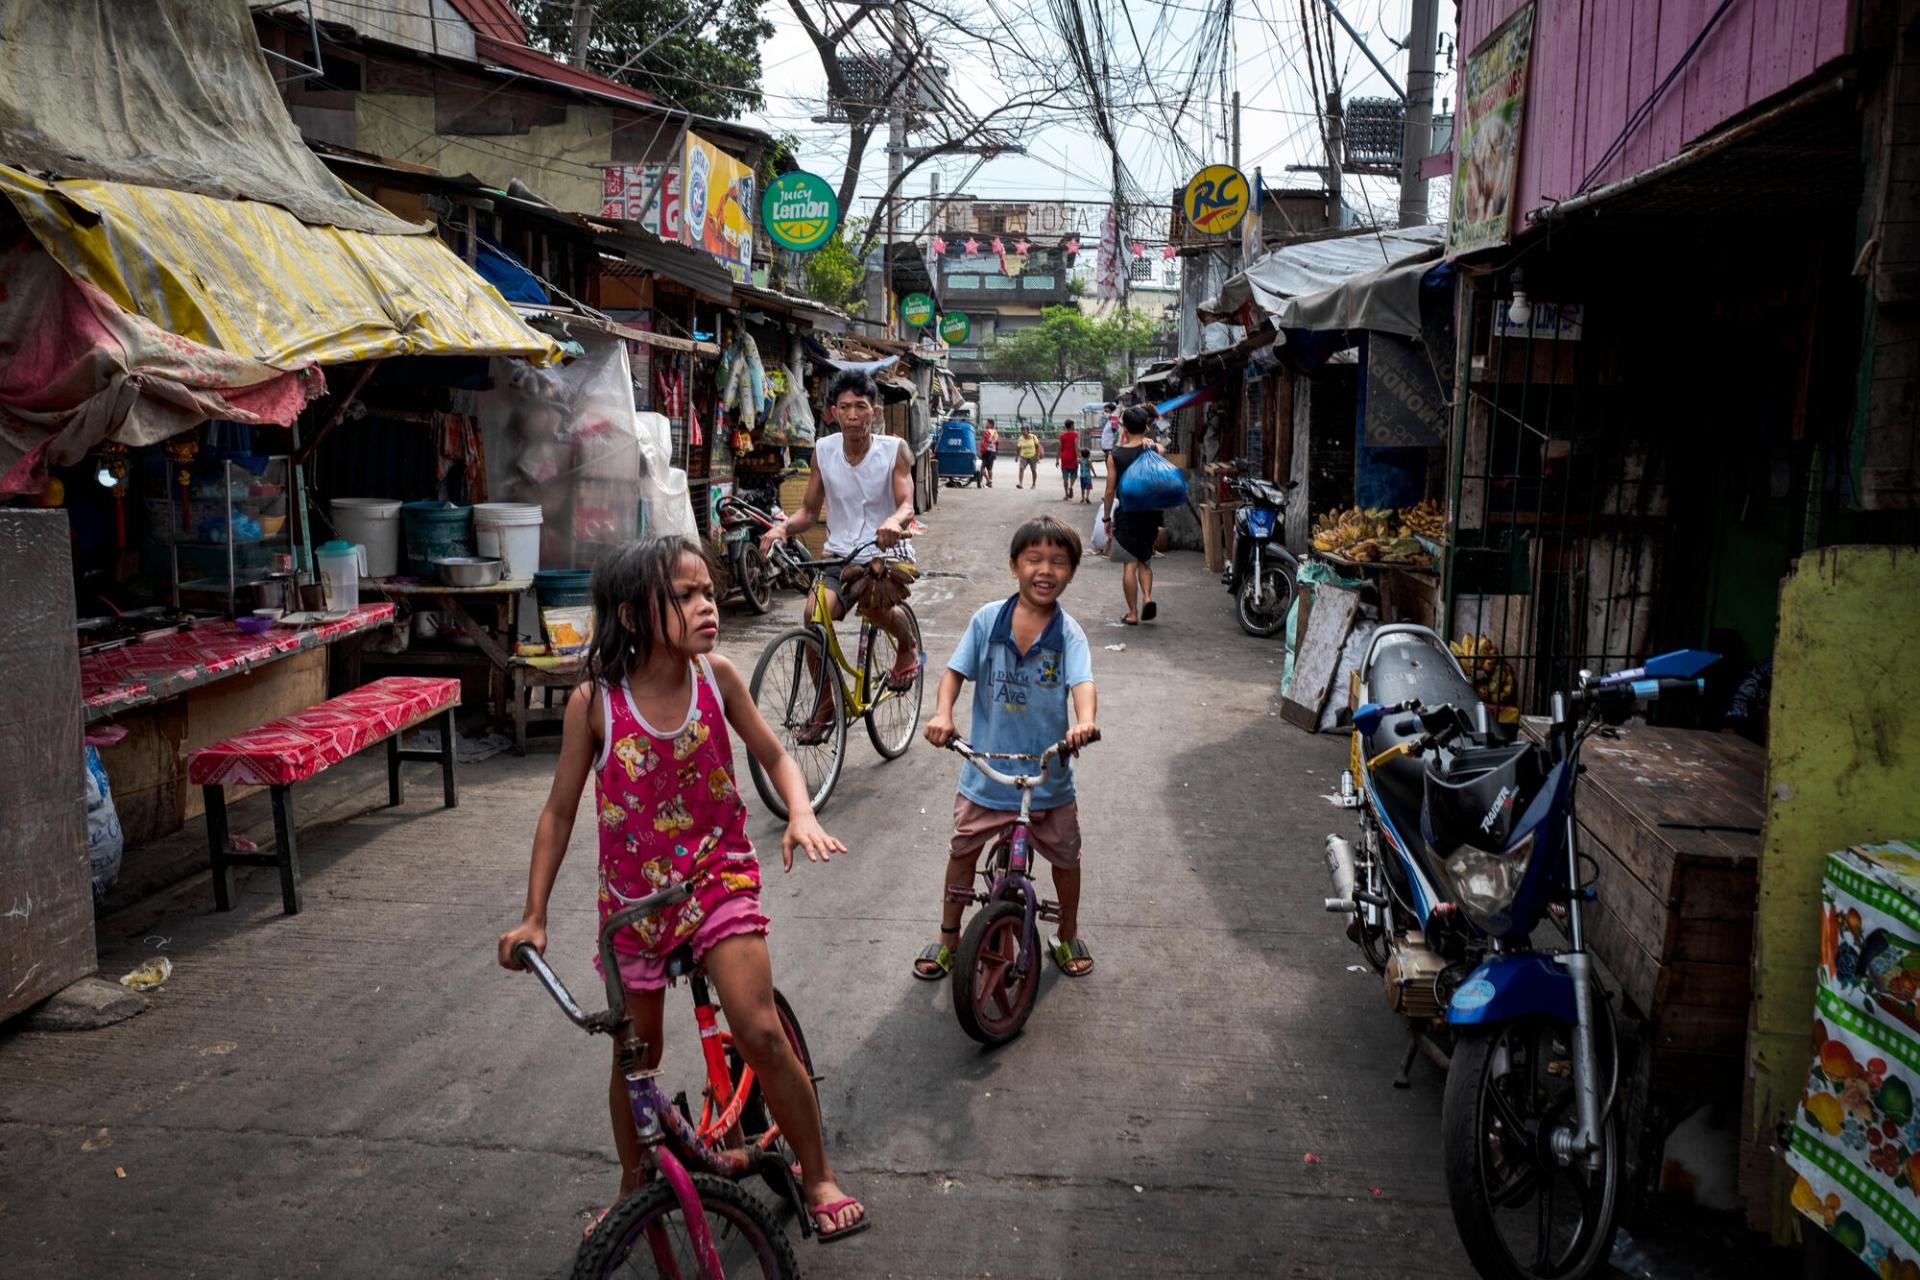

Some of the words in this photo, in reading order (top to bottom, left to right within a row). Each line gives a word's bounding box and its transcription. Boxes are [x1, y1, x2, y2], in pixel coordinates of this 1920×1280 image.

[1192, 174, 1239, 220] RC
[773, 201, 829, 220] Lemon
[994, 684, 1027, 705] Ave
